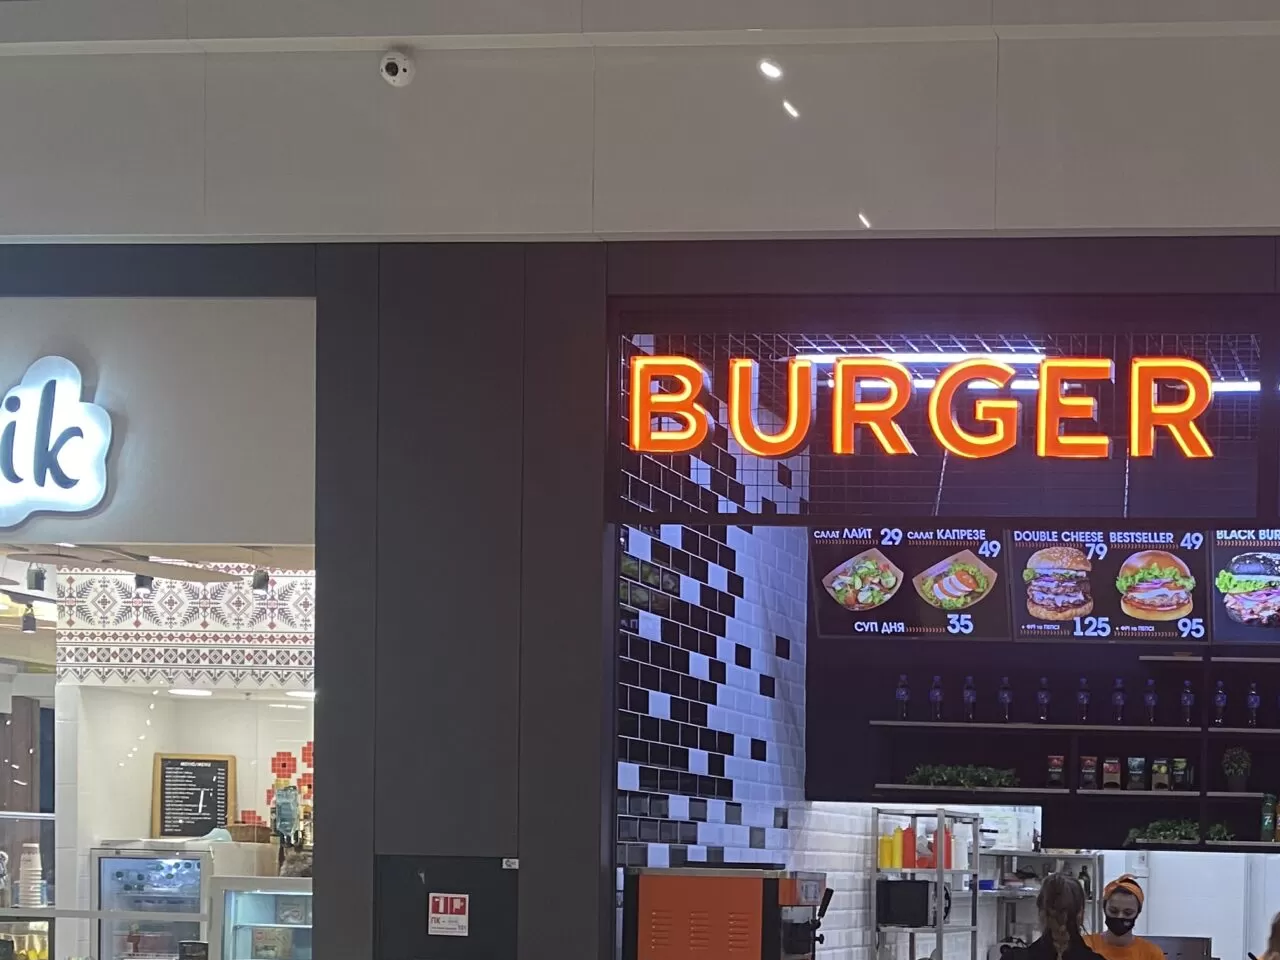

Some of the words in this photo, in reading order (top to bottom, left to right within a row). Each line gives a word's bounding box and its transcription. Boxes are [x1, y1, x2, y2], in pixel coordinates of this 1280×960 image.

[630, 355, 1214, 458] BURGER
[843, 527, 873, 539] ЛАЙТ
[880, 528, 903, 546] 29
[936, 529, 986, 540] КАПРЕЗЕ
[1013, 530, 1058, 542] DOUBLE
[1061, 531, 1104, 543] CHEESE
[1109, 532, 1174, 543] BESTSELLER
[1180, 532, 1204, 550] 49
[1216, 529, 1256, 540] BLACK
[978, 540, 1001, 558] 49
[1085, 543, 1108, 560] 79
[854, 621, 879, 632] СУП
[881, 622, 905, 634] ДНЯ
[946, 613, 974, 634] 35
[1072, 616, 1111, 637] 125
[1177, 618, 1205, 638] 95
